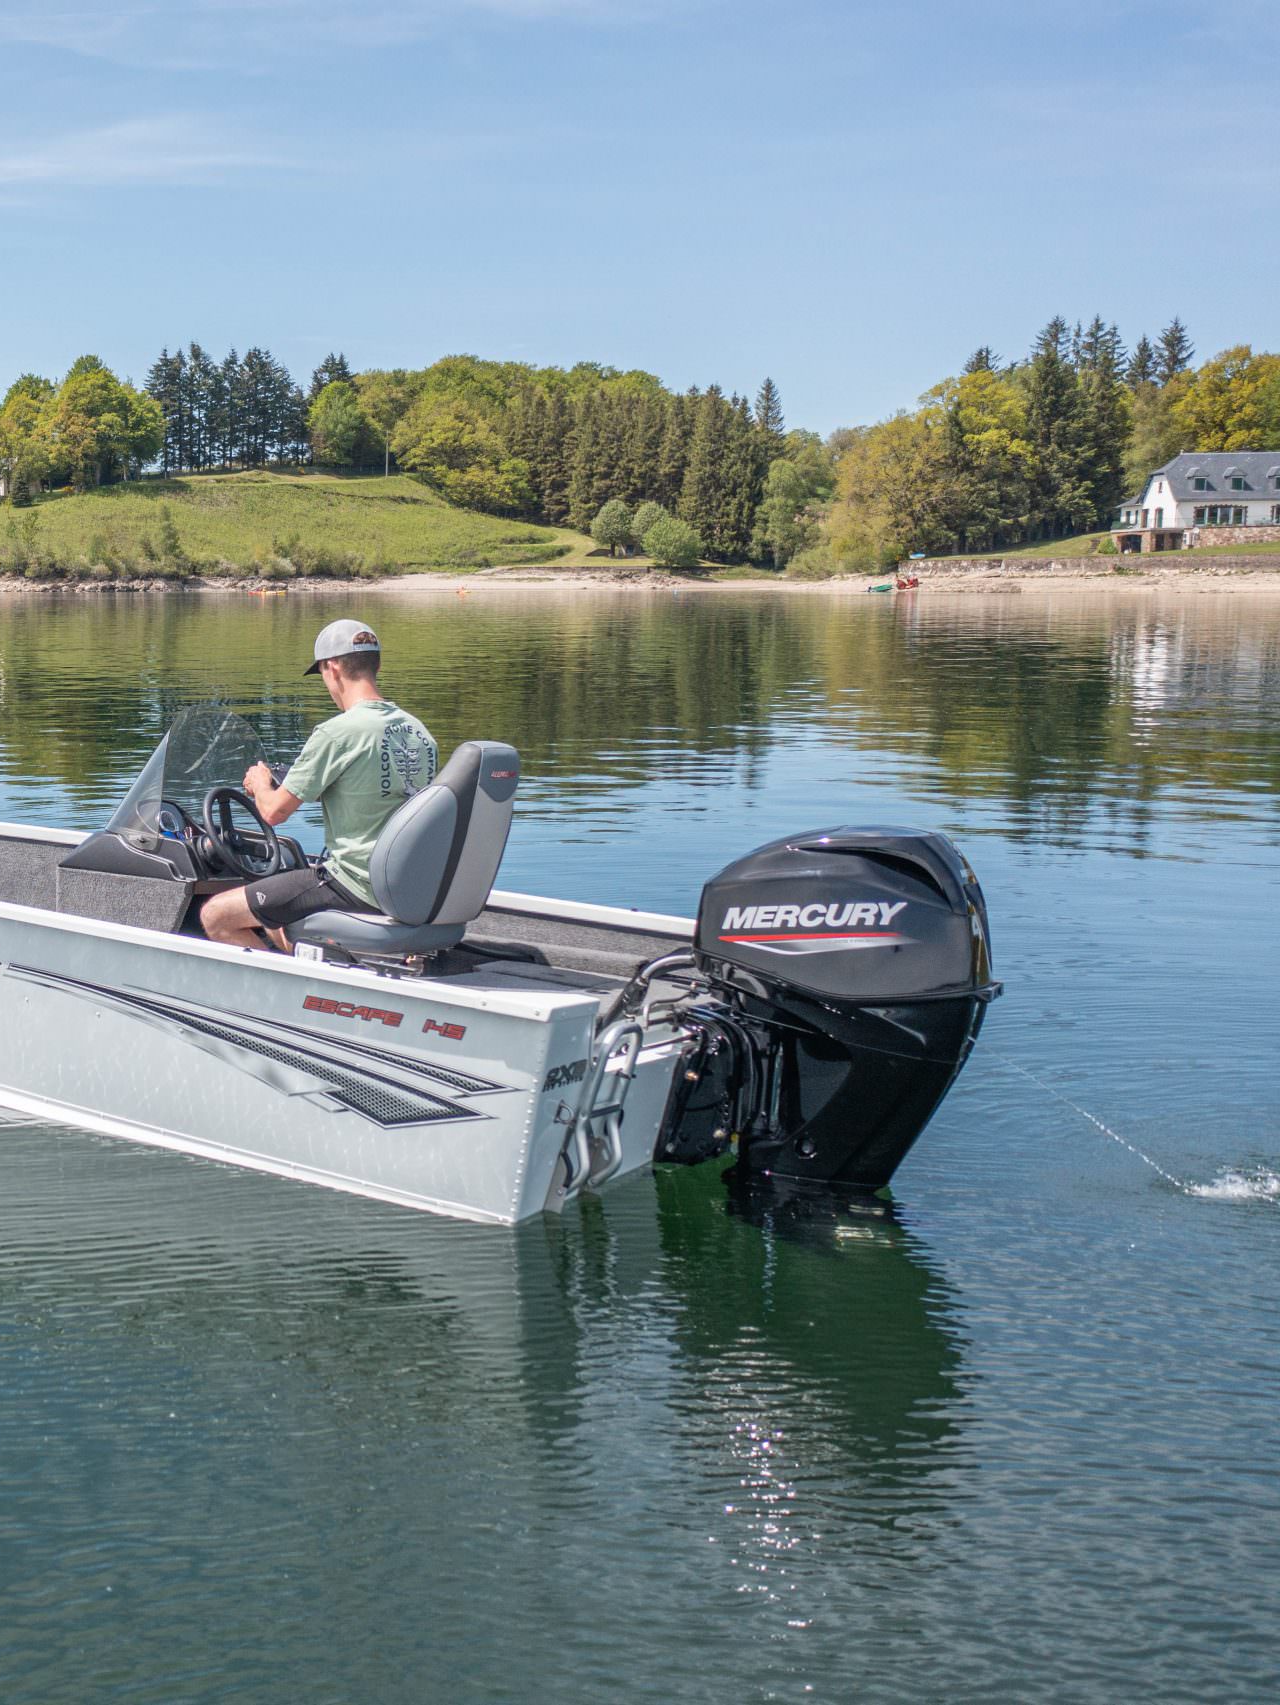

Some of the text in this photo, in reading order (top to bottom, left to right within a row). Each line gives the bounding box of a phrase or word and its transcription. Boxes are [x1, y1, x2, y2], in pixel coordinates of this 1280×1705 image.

[381, 738, 391, 797] VOLCOM
[416, 730, 434, 785] COMPAN
[721, 901, 908, 930] MERCURY
[303, 995, 404, 1027] ESCAPE
